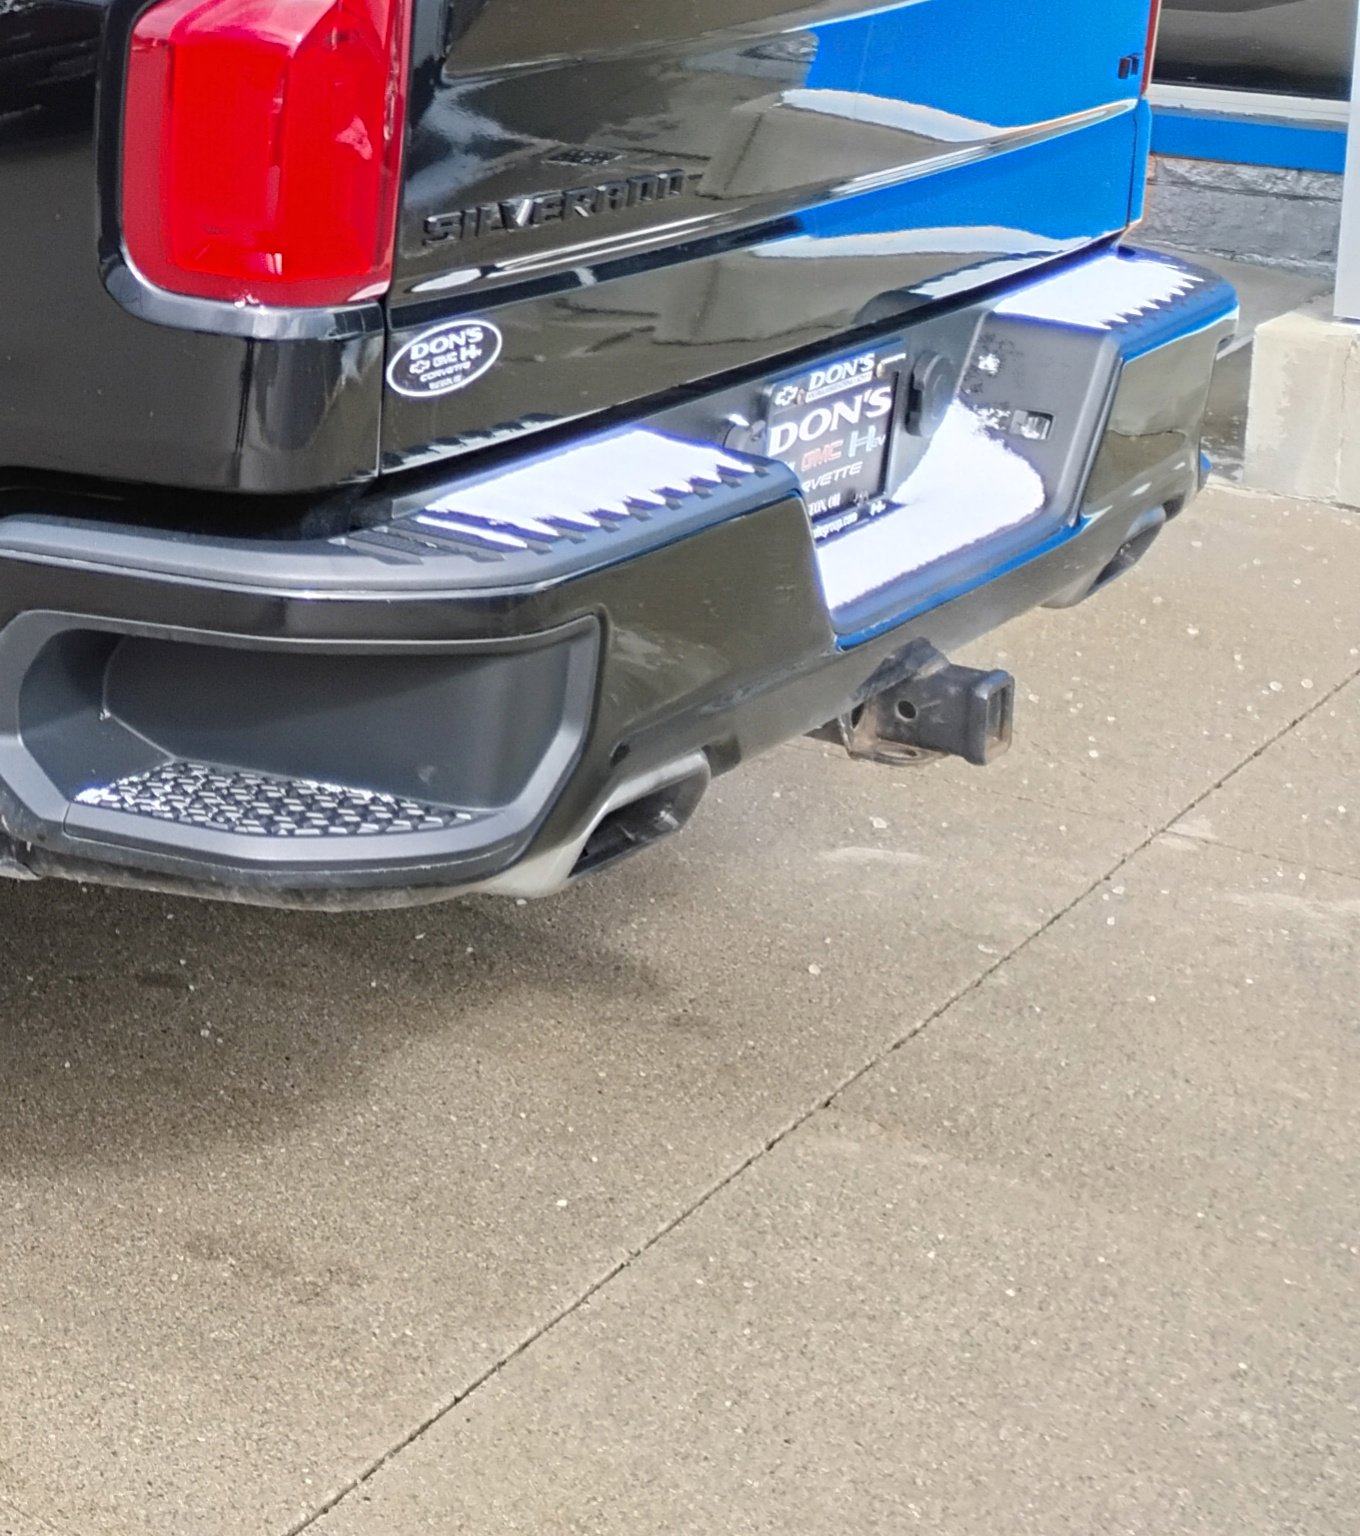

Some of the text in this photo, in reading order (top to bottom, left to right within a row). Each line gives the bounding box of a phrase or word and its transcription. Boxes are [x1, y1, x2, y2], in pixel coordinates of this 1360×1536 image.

[422, 168, 685, 247] SILVERADO
[808, 353, 875, 391] DON'S
[766, 385, 893, 458] DON'S
[800, 439, 844, 472] GMC
[801, 461, 864, 493] RVETTE
